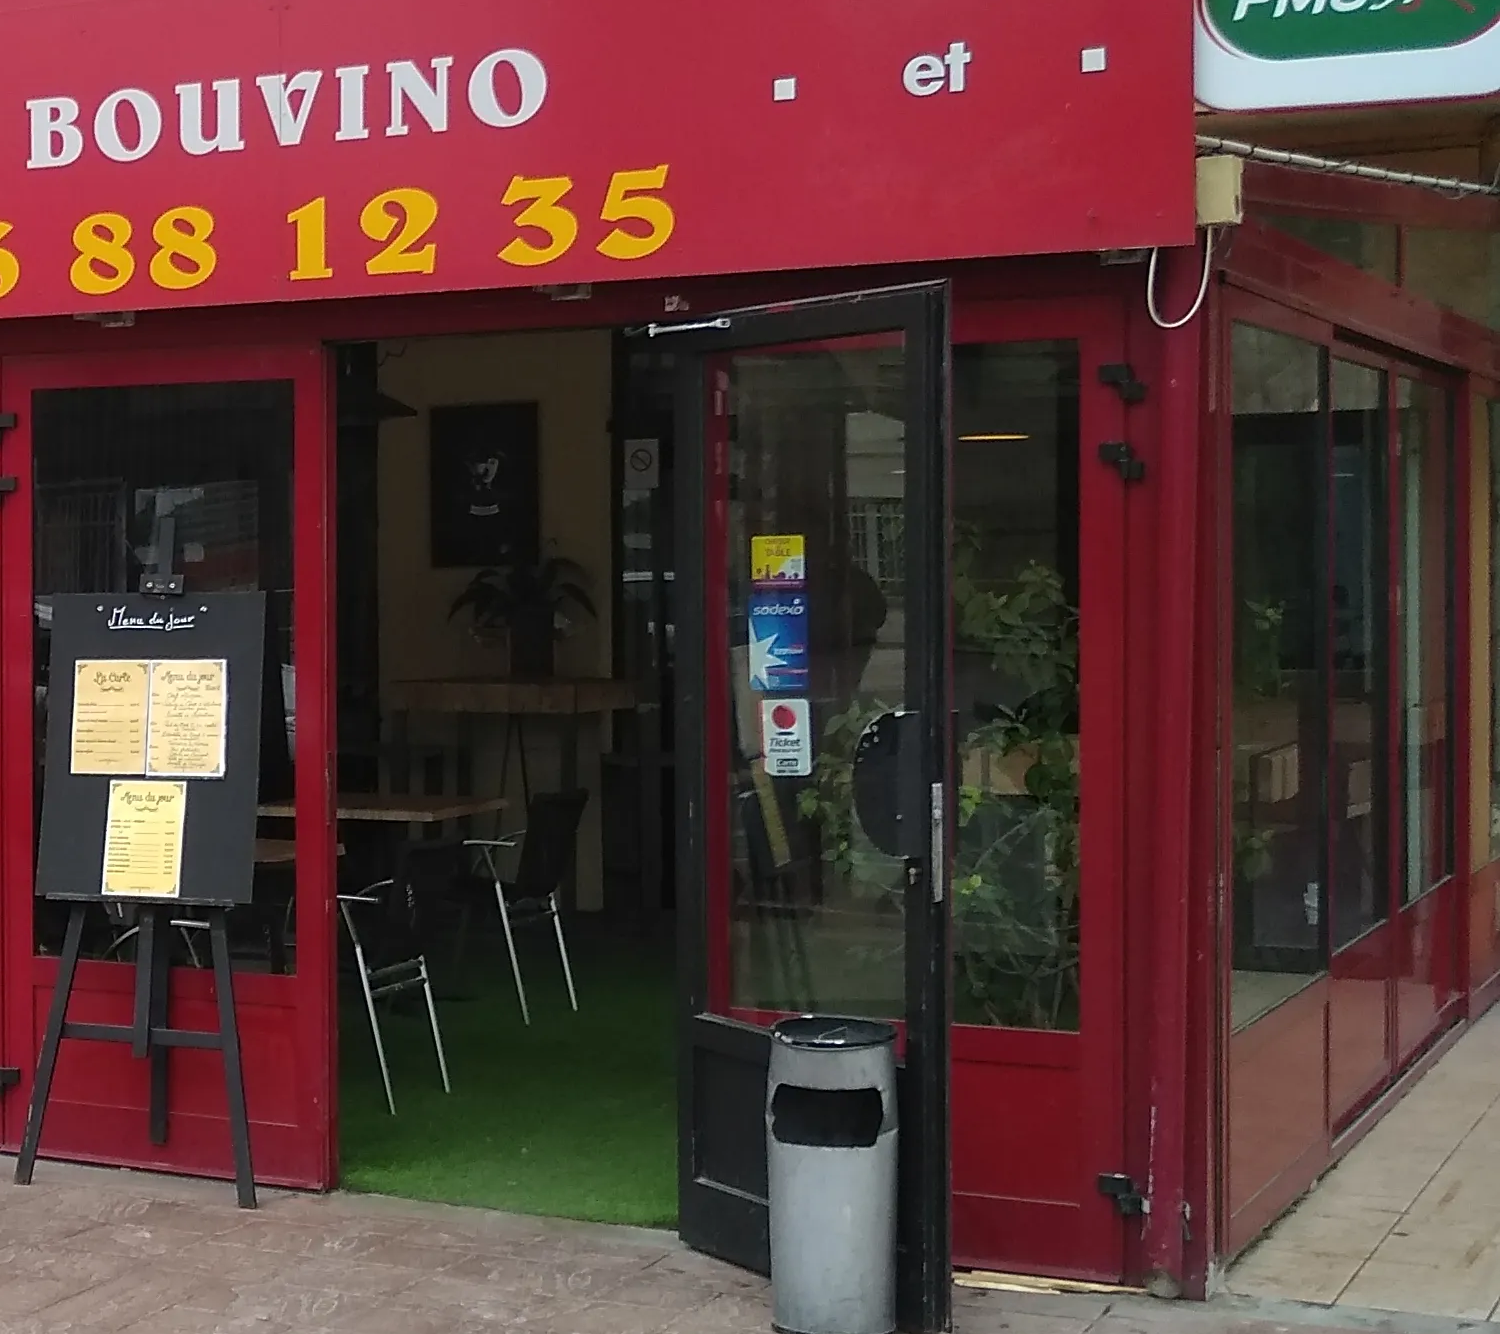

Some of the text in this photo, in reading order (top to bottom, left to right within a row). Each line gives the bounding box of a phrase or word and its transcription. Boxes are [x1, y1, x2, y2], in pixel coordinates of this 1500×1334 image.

[902, 42, 972, 97] et
[24, 47, 548, 170] BOUVINO
[69, 205, 217, 295] 88
[286, 187, 439, 281] 12
[497, 164, 675, 266] 35
[107, 605, 195, 631] Menu du jour
[752, 601, 805, 616] sodexo
